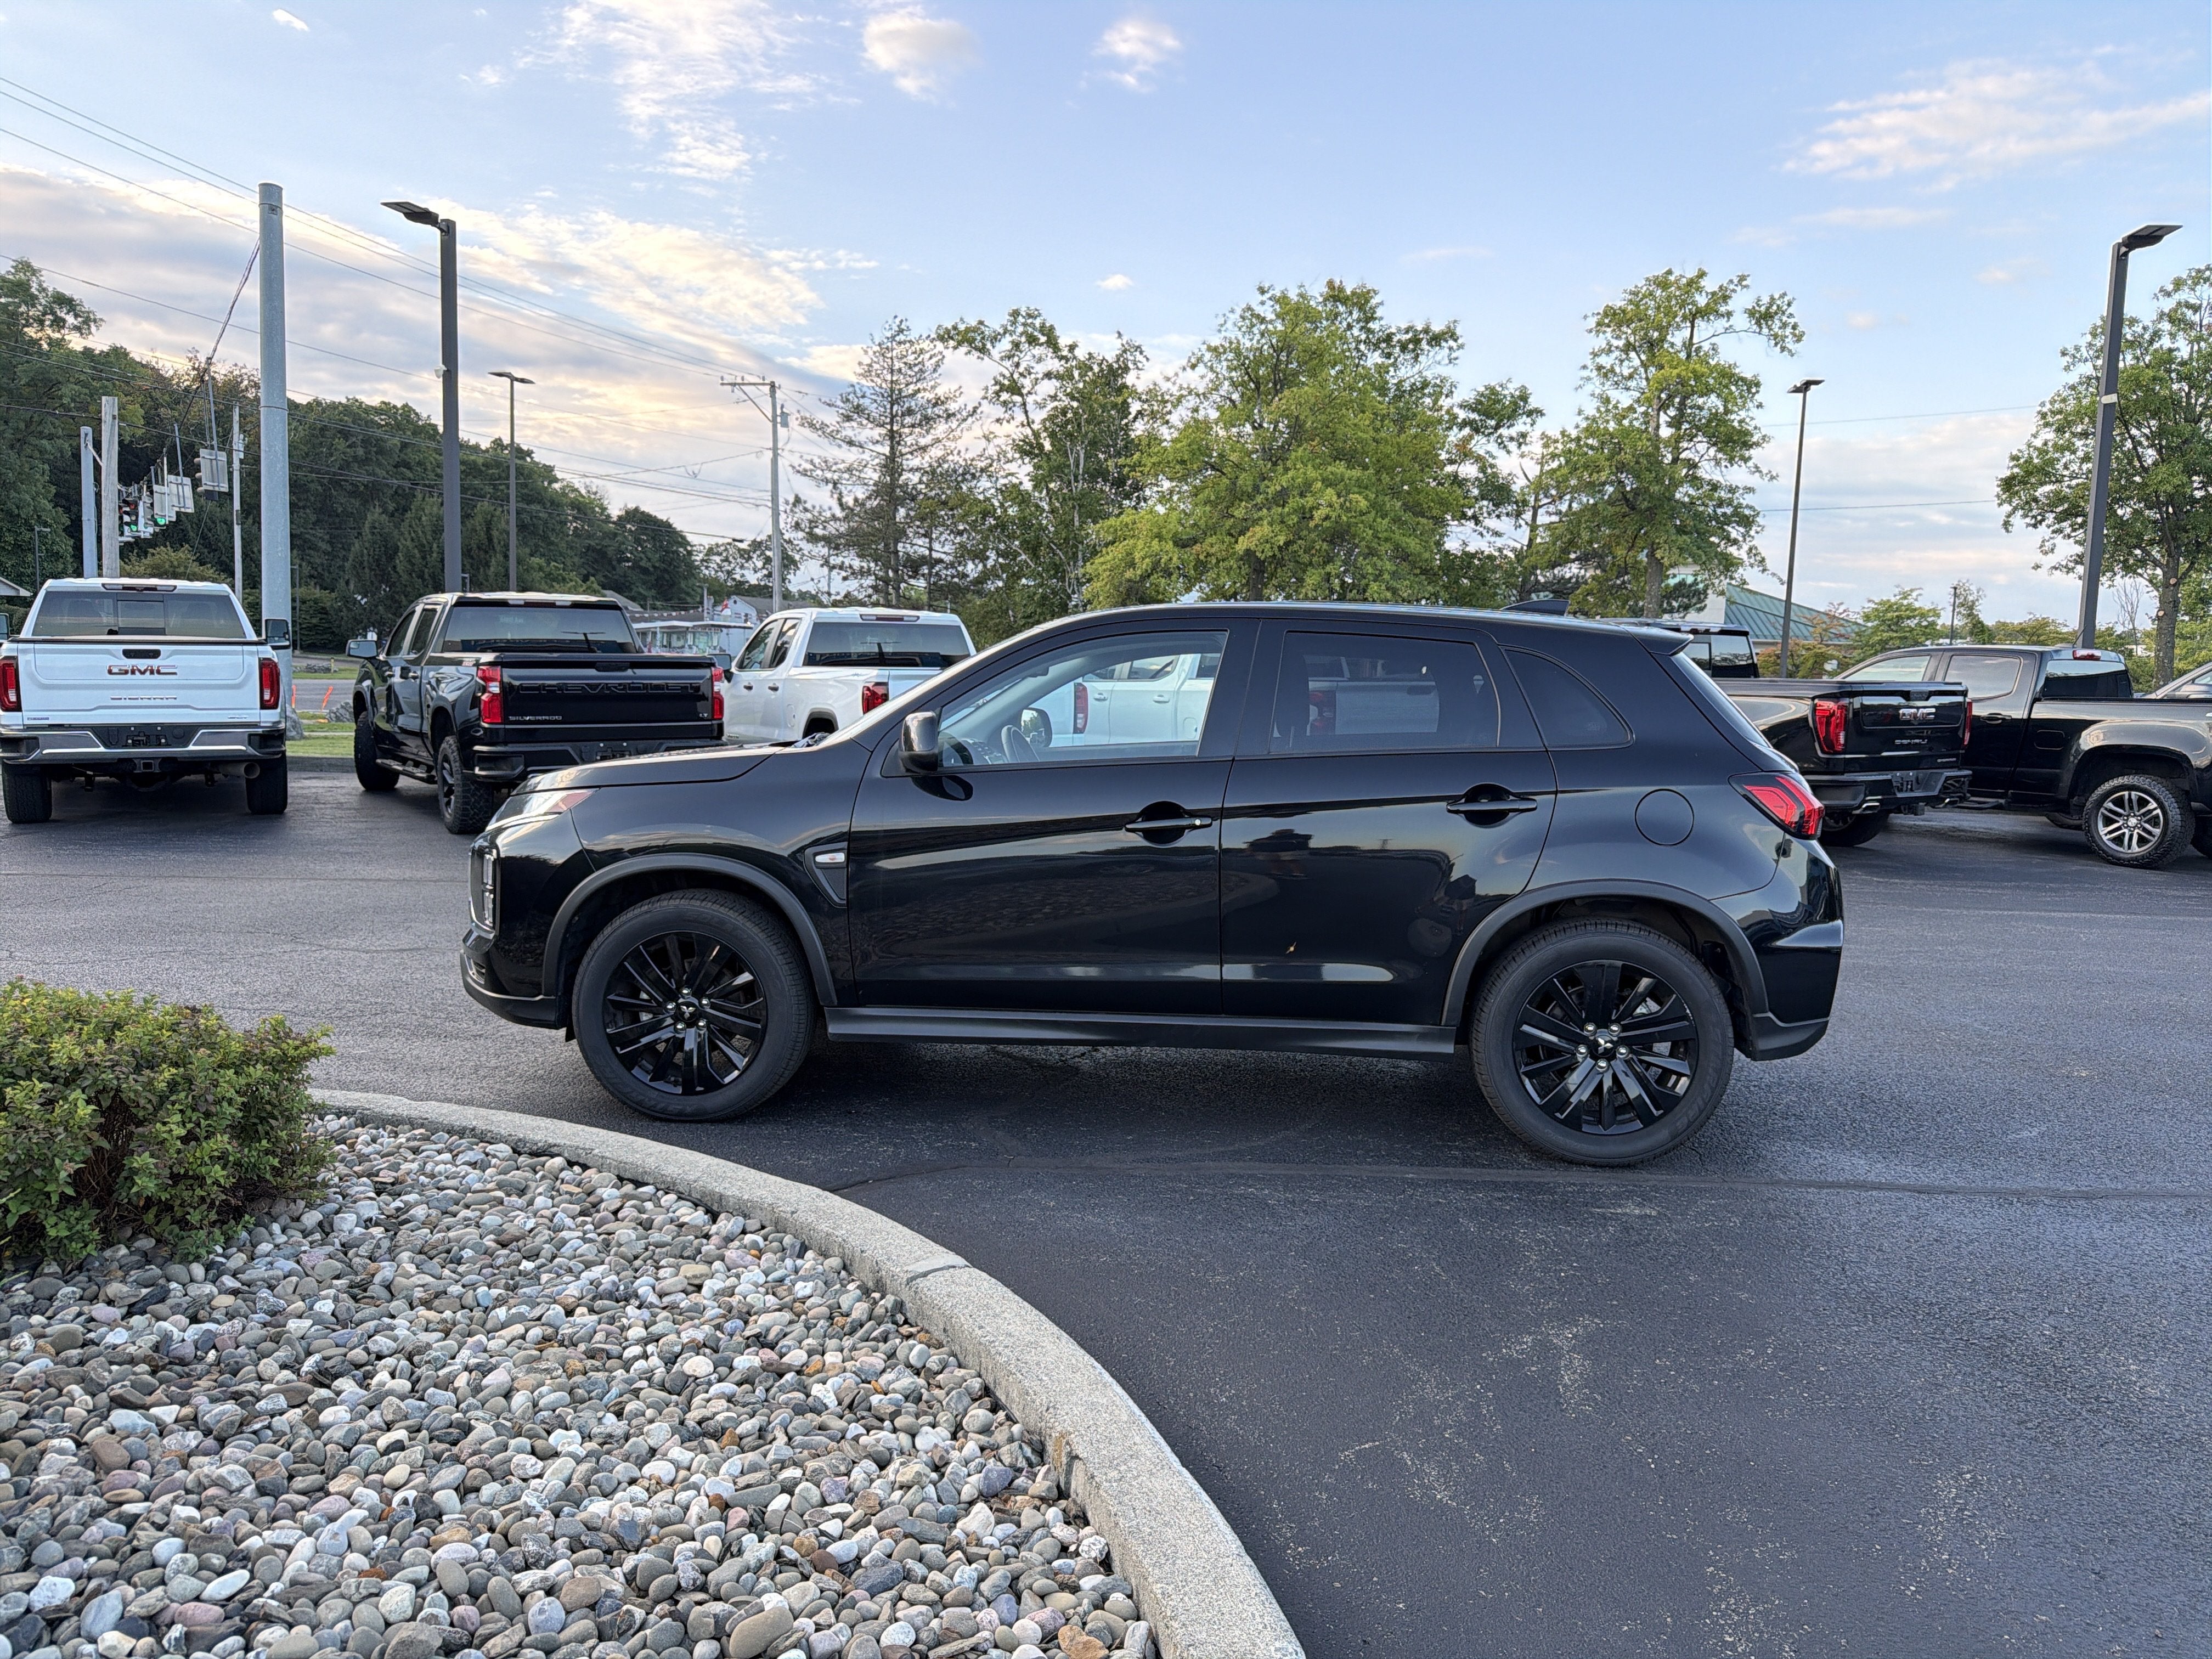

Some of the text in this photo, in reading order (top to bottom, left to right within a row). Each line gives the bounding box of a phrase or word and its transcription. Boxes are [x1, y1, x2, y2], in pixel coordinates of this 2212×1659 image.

[107, 664, 178, 676] GMC
[520, 682, 698, 693] CHEVROLET
[1899, 708, 1936, 721] GMC
